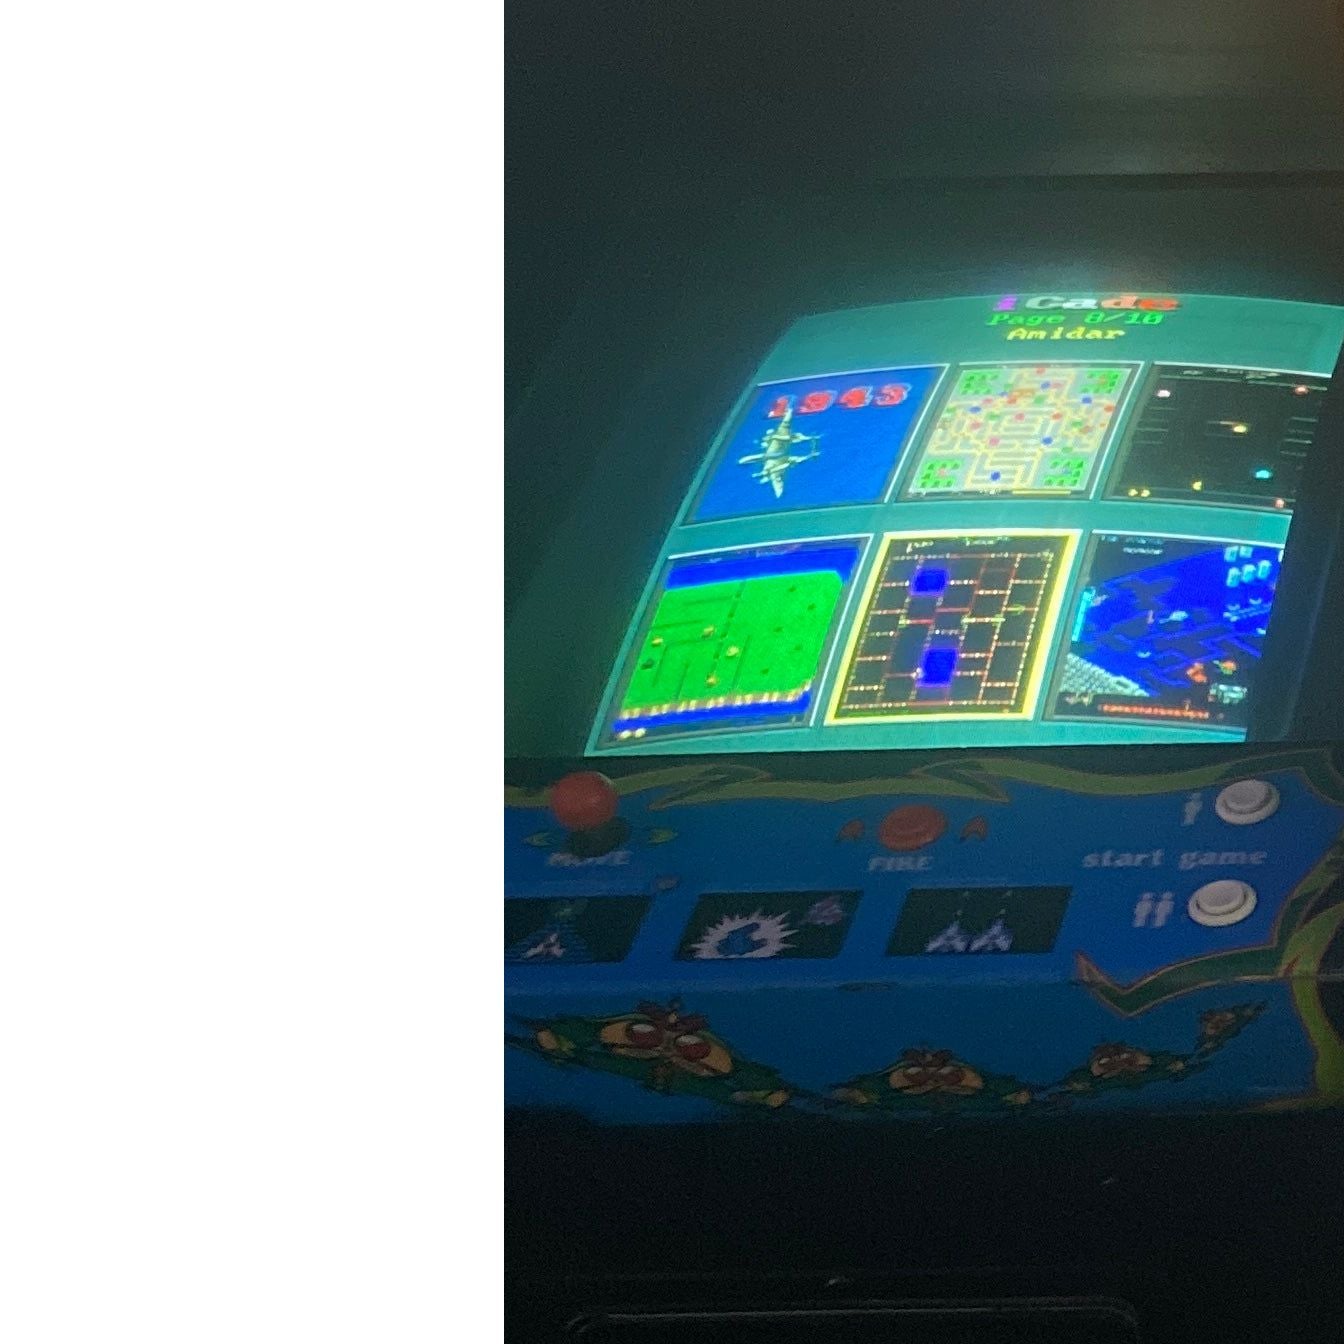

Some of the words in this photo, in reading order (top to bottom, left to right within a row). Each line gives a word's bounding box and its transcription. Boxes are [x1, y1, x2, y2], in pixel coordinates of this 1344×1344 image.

[986, 312, 1066, 327] Page
[1006, 326, 1127, 342] Amidar
[867, 855, 934, 873] FIRE
[1081, 848, 1165, 870] start
[1176, 847, 1269, 871] game
